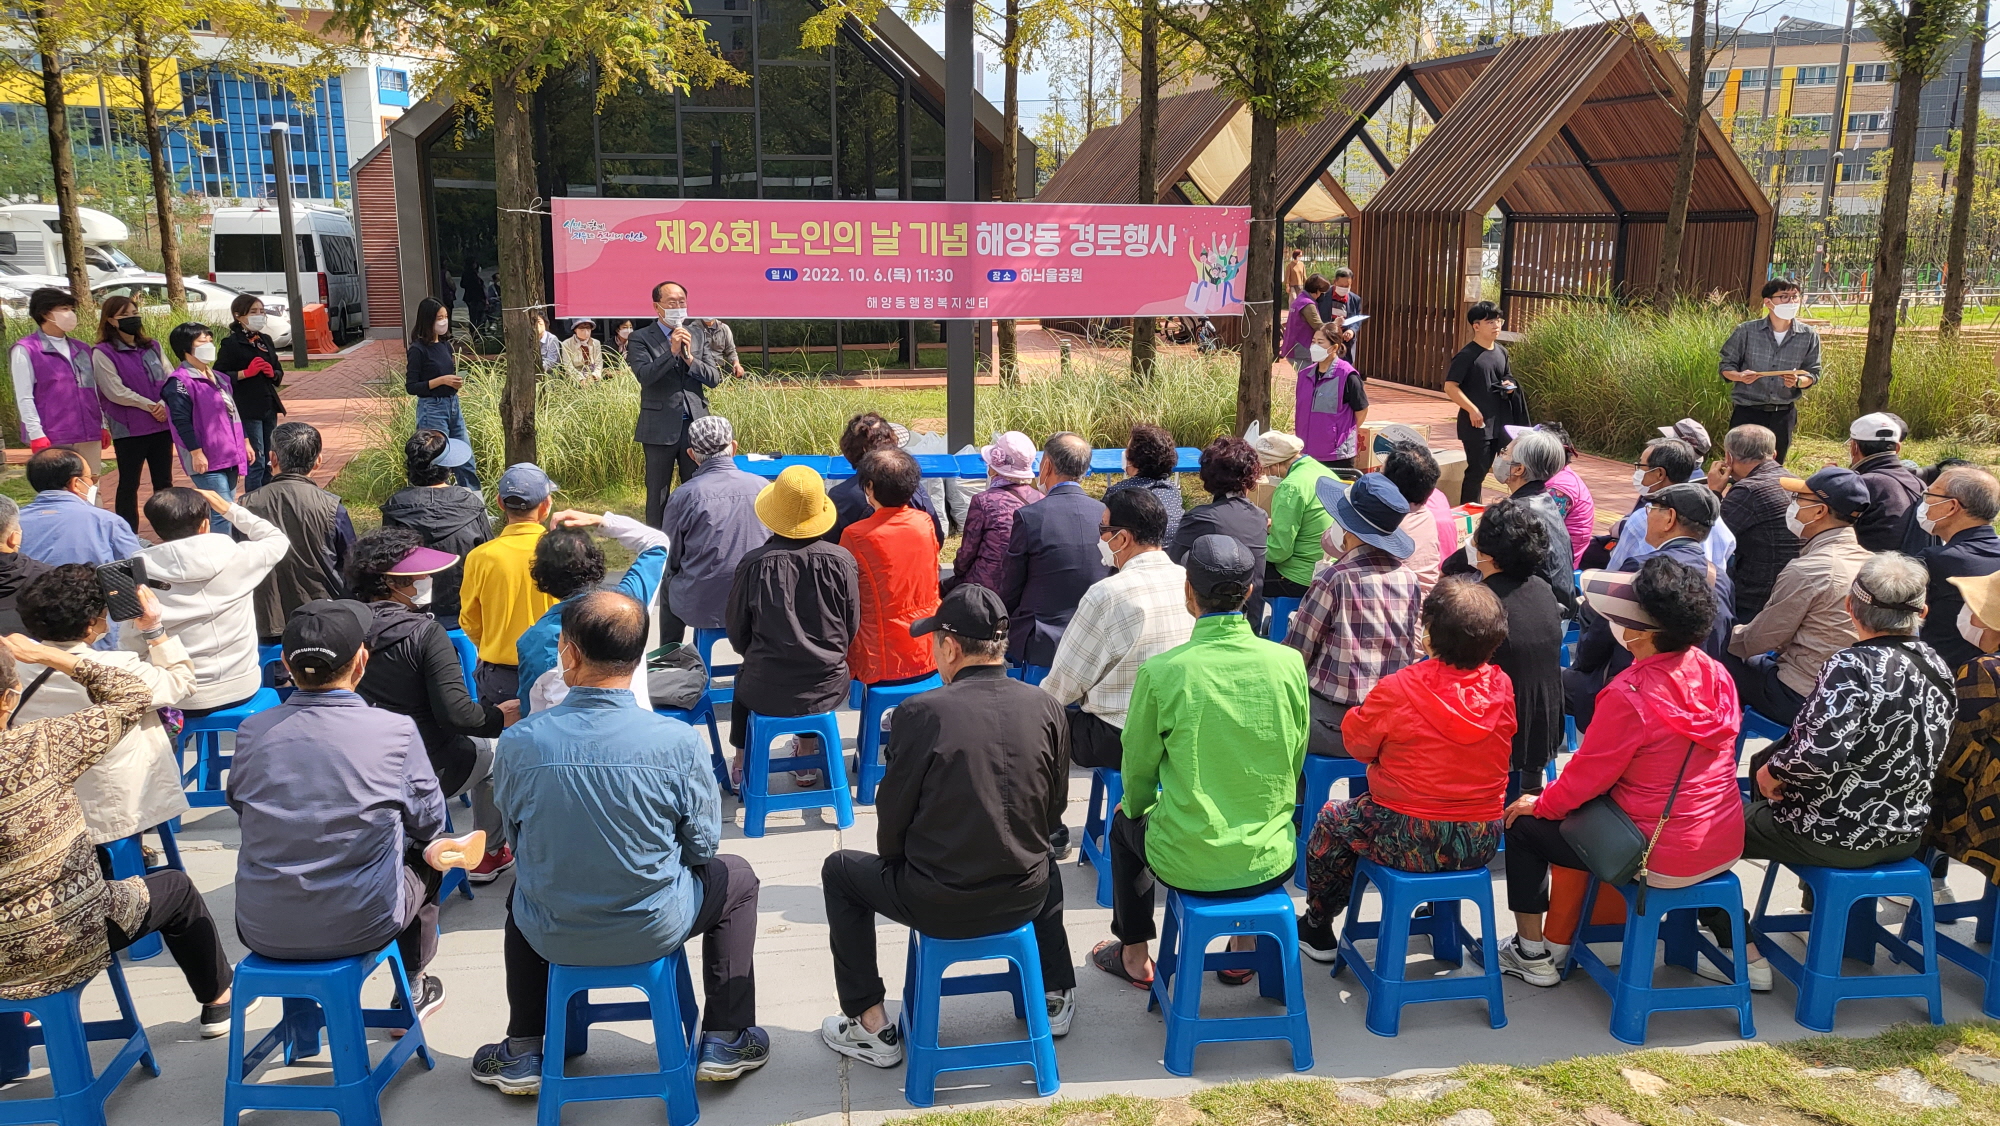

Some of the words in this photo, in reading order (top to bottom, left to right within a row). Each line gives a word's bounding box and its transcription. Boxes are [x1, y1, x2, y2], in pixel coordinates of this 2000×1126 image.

[624, 231, 648, 242] 안산
[655, 219, 760, 255] 제26회
[769, 221, 862, 256] 노인의
[871, 221, 901, 256] 날
[909, 221, 968, 257] 기념
[976, 221, 1061, 257] 해양동
[1069, 223, 1177, 258] 경로행사
[802, 267, 844, 282] 2022.
[848, 267, 869, 282] 10.
[873, 267, 912, 283] 6.(목)
[915, 268, 954, 283] 11:30
[1020, 267, 1083, 283] 하늬울공원
[866, 296, 989, 310] 해양동행정복지센터
